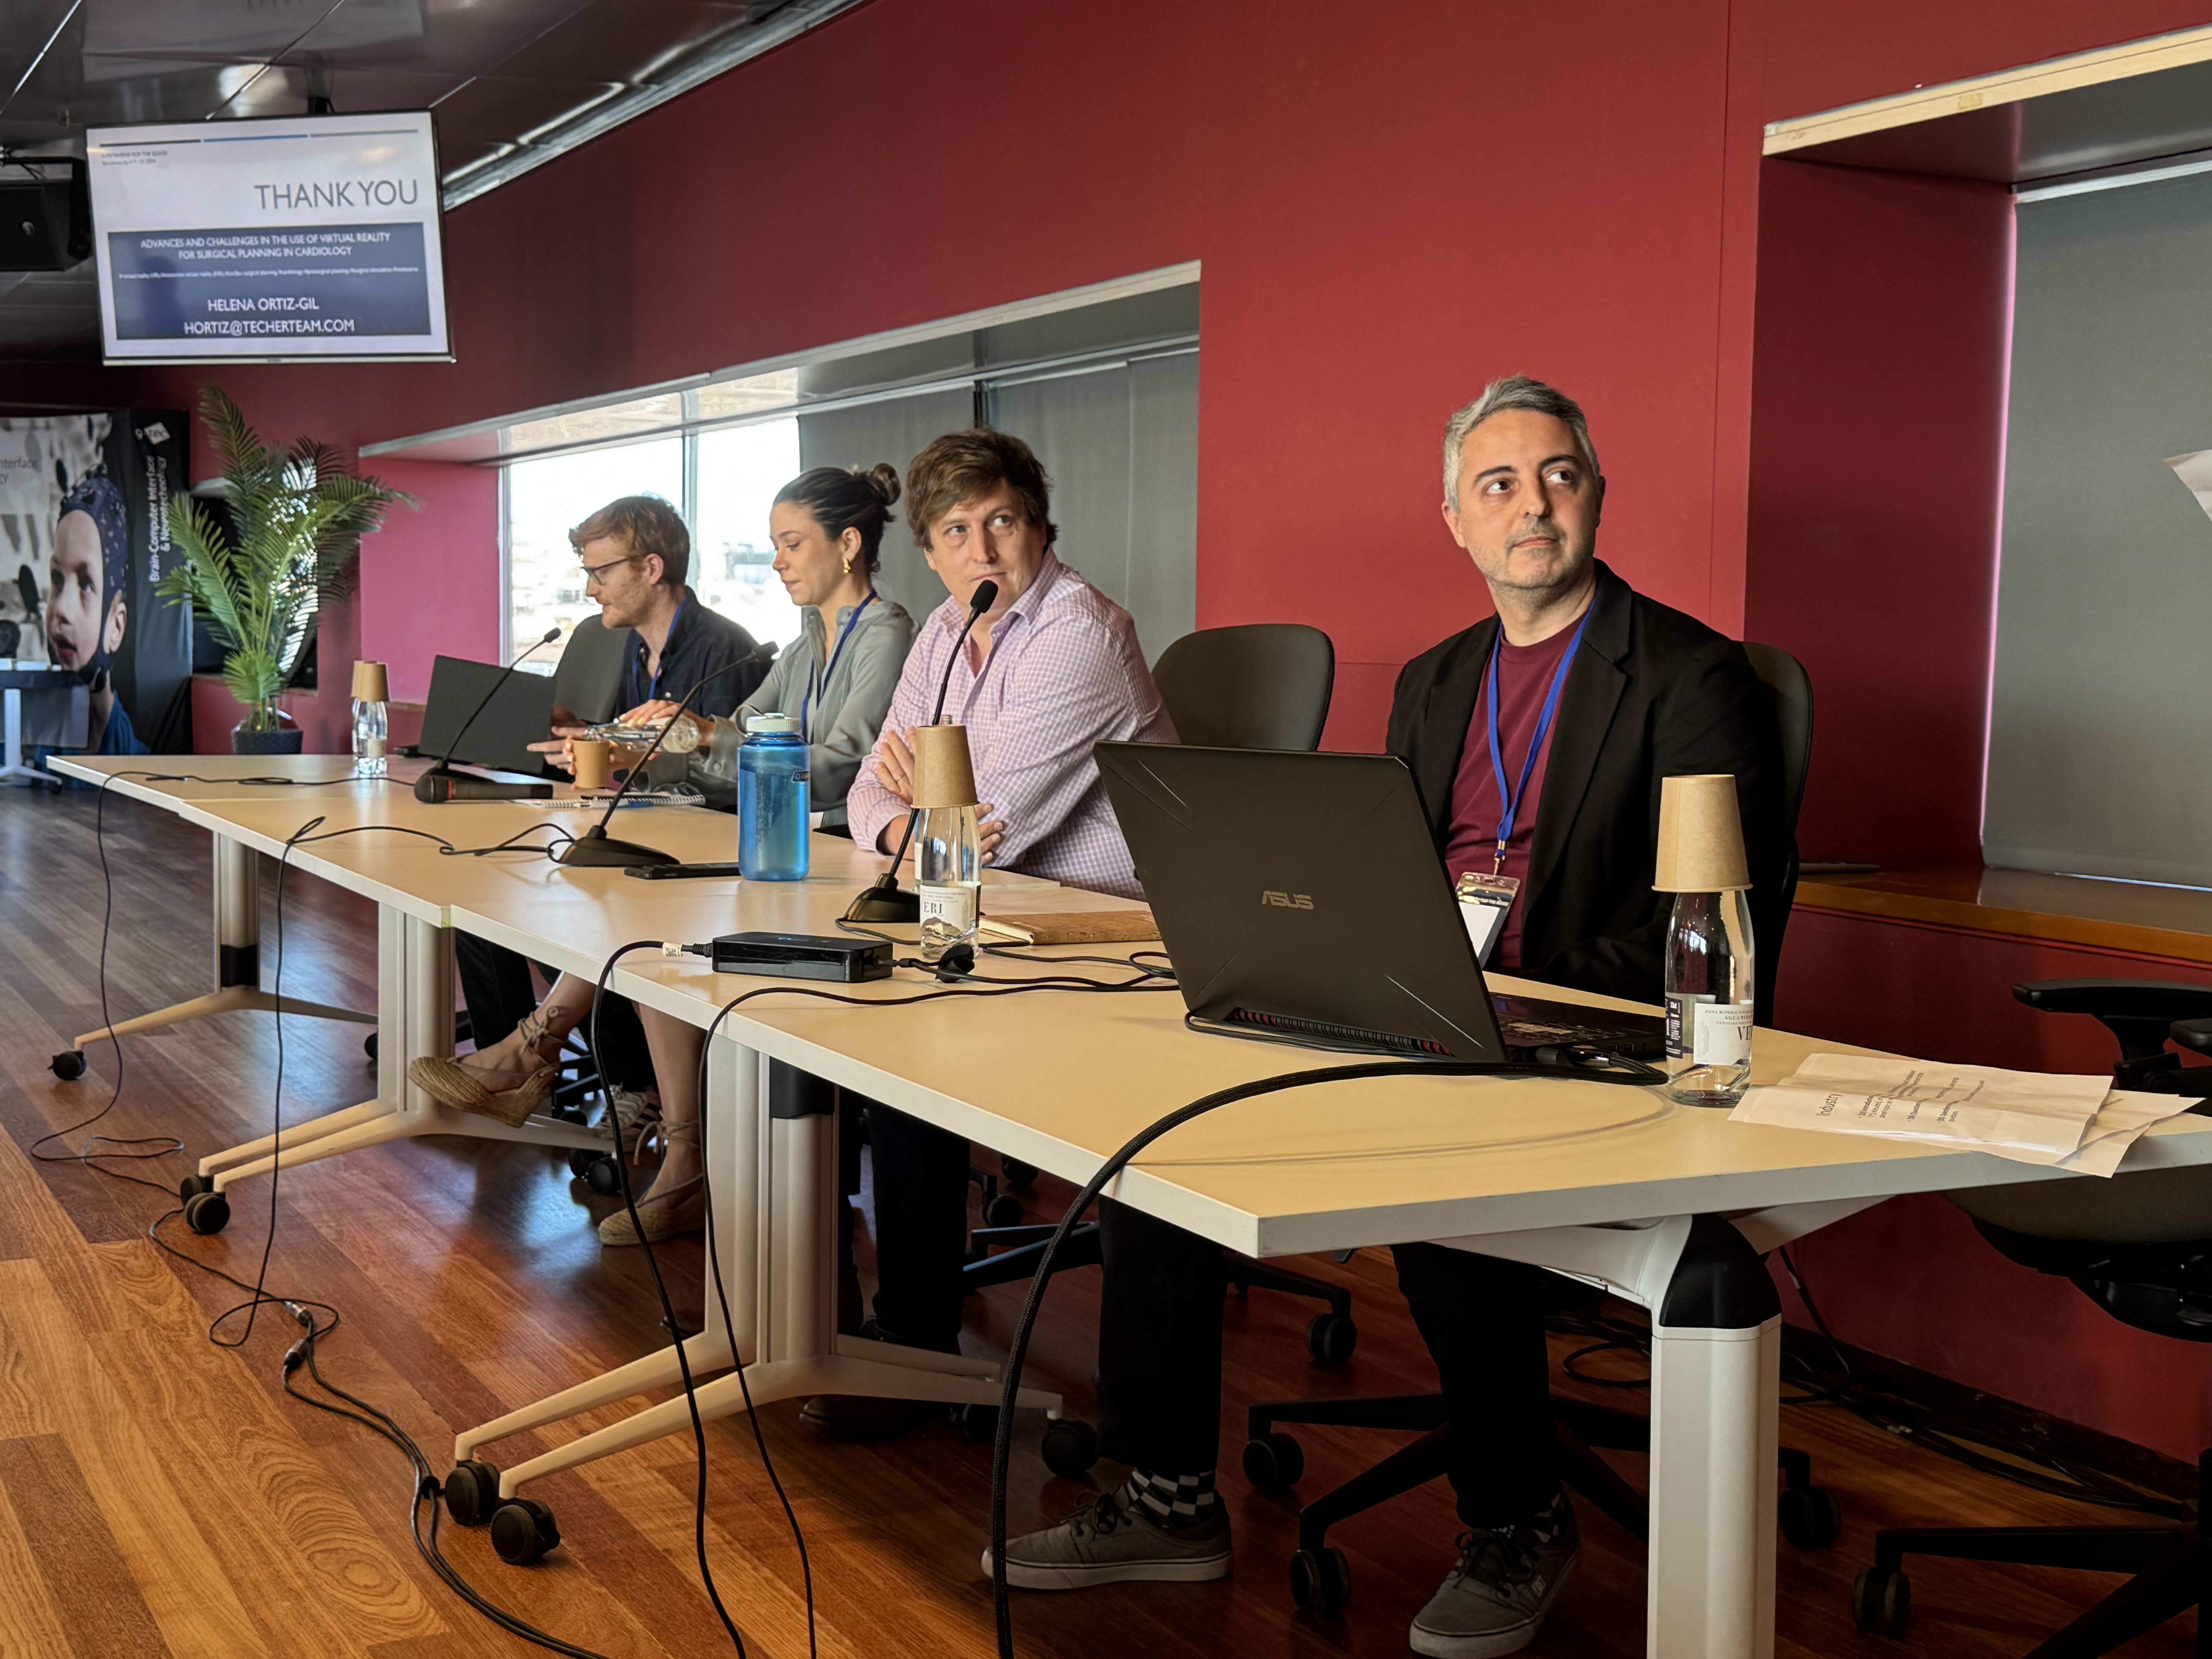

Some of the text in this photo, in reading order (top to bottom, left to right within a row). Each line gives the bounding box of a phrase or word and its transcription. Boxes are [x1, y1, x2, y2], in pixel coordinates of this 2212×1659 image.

[254, 179, 418, 209] THANK YOU
[141, 232, 391, 248] ADVANCES AND CHALLENGES IN THE USE OF VIRTUAL REALITY
[178, 246, 352, 260] FOR SURGICAL PLANNING IN CARDIOLOGY
[208, 297, 319, 311] HELENA ORTIZ-GIL
[184, 319, 355, 336] HORTIZ@TECHERTEAM.COM
[146, 455, 160, 582] Brain-Computer Interface
[922, 901, 942, 914] ERI
[1262, 890, 1314, 910] ASUS
[1815, 1092, 1844, 1116] Industry
